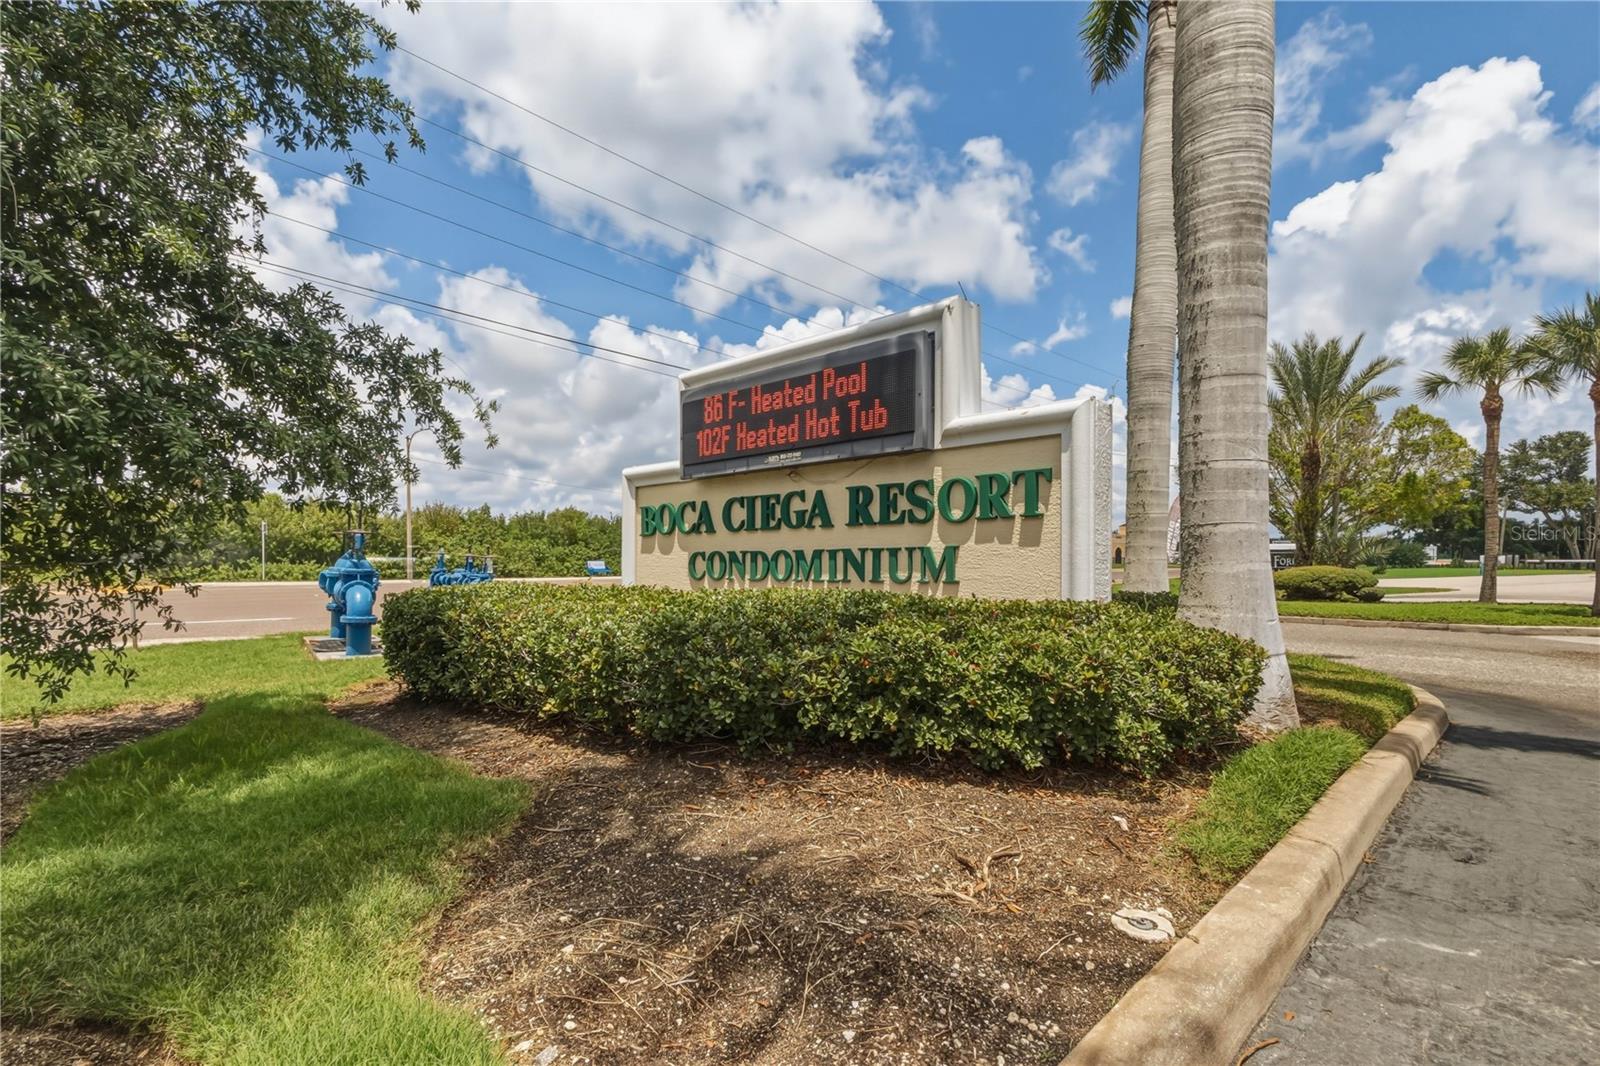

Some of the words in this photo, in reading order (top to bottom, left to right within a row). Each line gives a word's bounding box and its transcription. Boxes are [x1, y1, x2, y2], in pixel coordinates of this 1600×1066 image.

[704, 393, 723, 424] 86
[751, 374, 816, 415] Heated
[823, 362, 867, 400] Pool
[696, 424, 731, 457] 102F
[736, 413, 799, 451] Heated
[806, 407, 841, 440] Hot
[848, 399, 889, 433] Tub
[640, 500, 716, 536] BOCA
[722, 490, 834, 532] CIEGA
[845, 467, 1052, 527] RESORT
[688, 545, 960, 584] CONDOMINIUM
